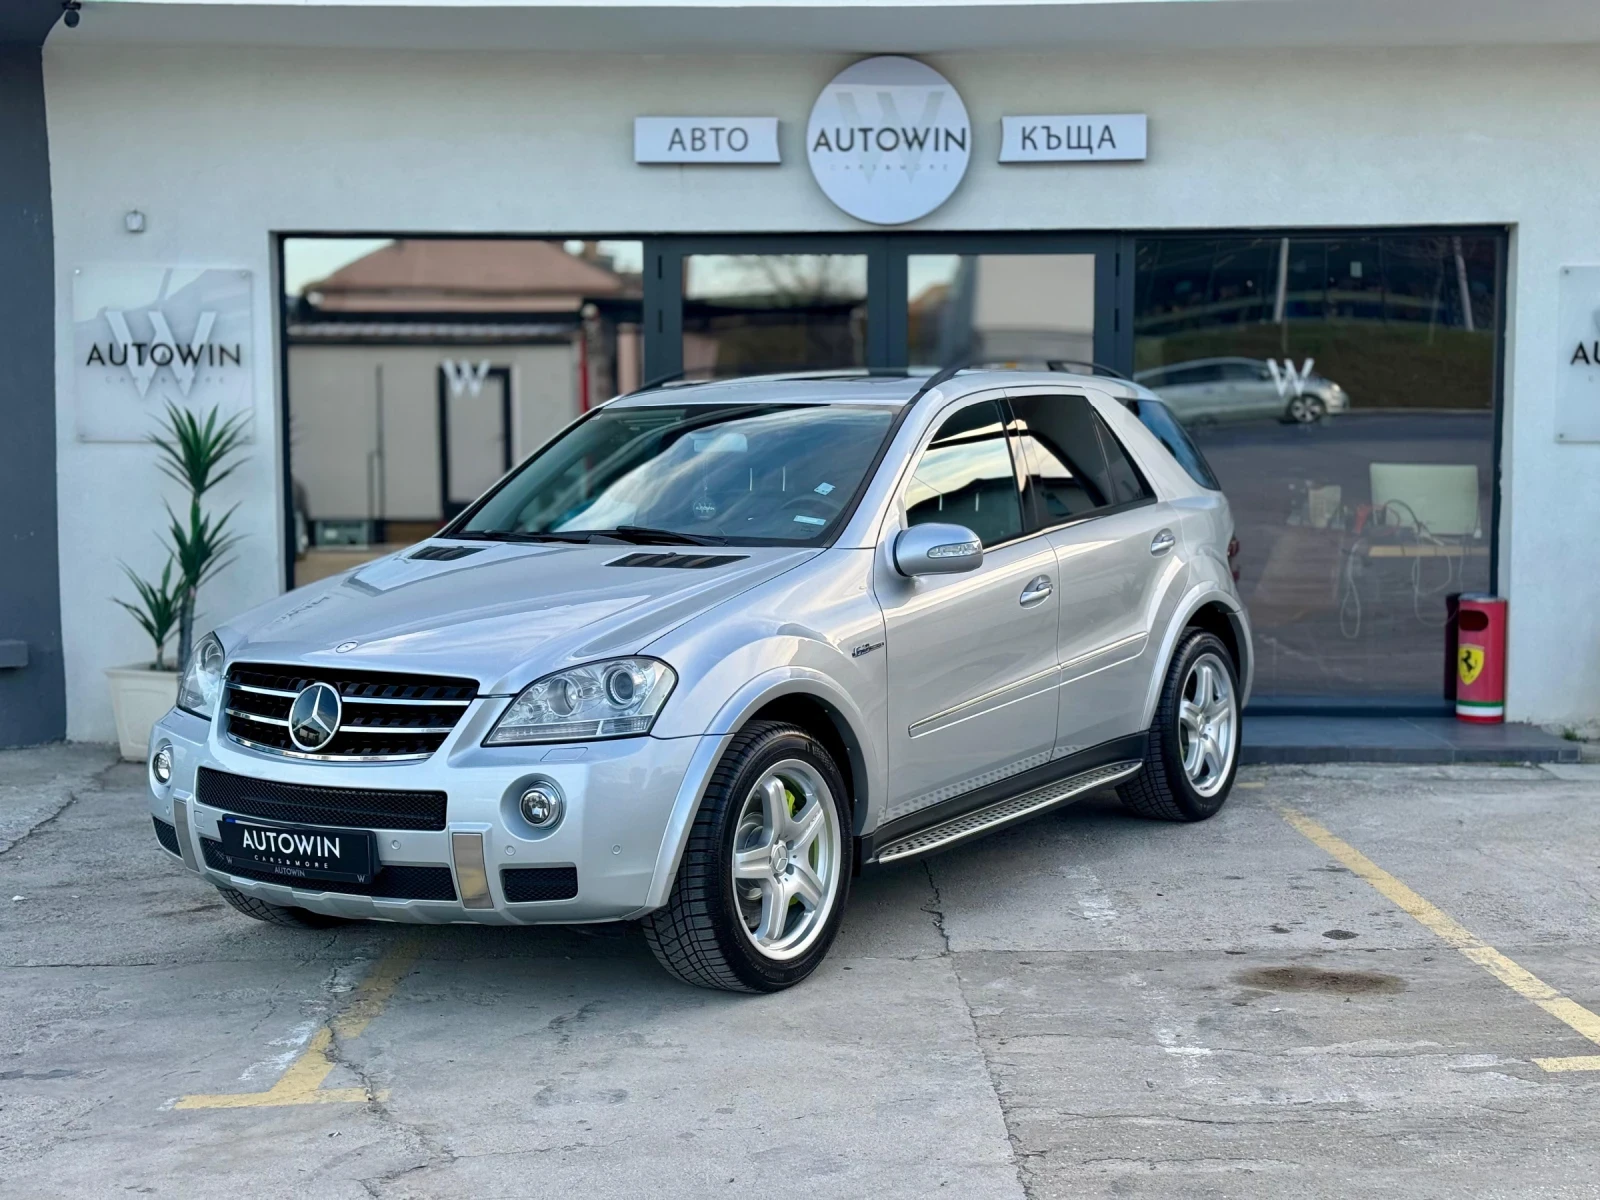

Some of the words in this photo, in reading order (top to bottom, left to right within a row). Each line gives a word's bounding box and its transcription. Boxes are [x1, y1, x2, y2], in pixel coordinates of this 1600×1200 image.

[667, 127, 749, 152] АВТО
[813, 127, 966, 152] AUTOWIN
[1021, 125, 1117, 155] КЪЩА
[86, 342, 242, 367] AUTOWIN
[441, 359, 491, 398] W
[1266, 358, 1315, 397] W
[242, 828, 341, 859] AUTOWIN
[274, 865, 306, 877] AUTOWIN
